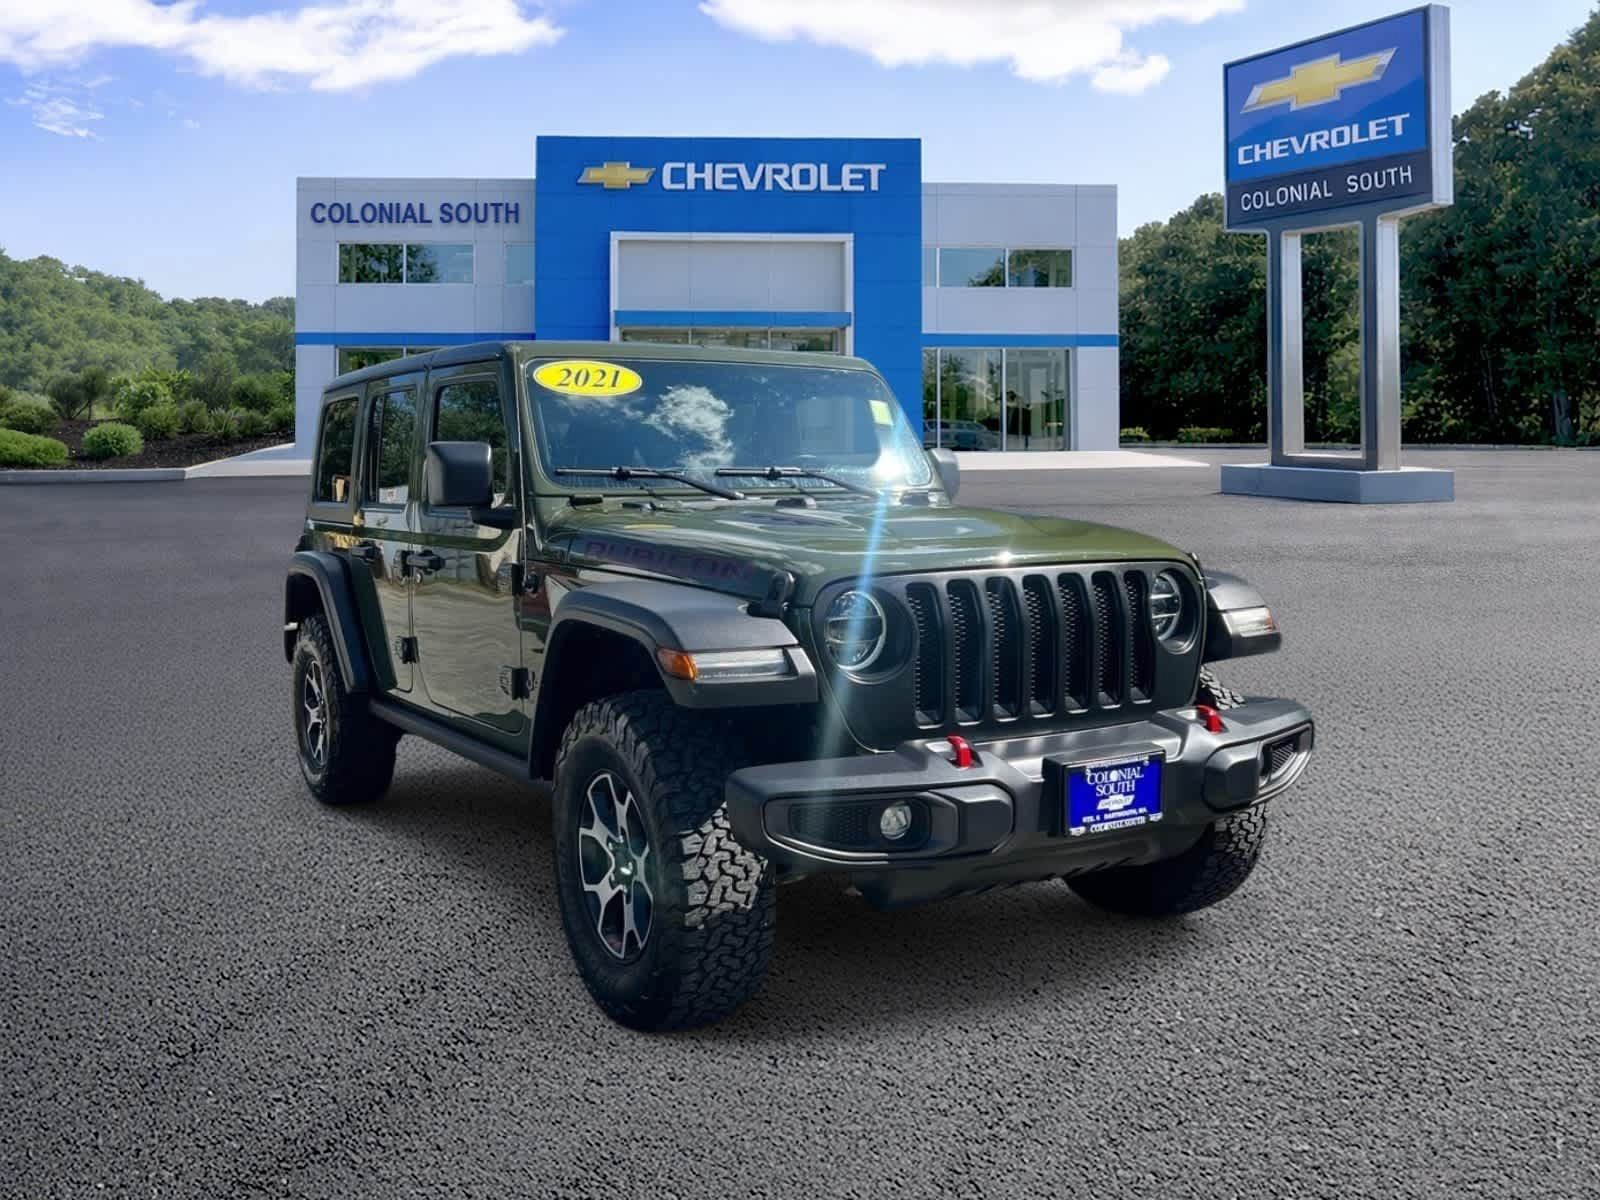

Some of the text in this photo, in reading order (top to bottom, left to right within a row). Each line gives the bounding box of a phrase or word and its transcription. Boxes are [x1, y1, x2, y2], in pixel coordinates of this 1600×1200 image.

[1237, 113, 1410, 165] CHEVROLET
[662, 162, 887, 191] CHEVROLET
[1240, 165, 1412, 211] COLONIAL SOUTH
[310, 202, 520, 224] COLONIAL SOUTH
[556, 368, 621, 388] 2021
[585, 541, 755, 580] RUBICON
[1087, 767, 1145, 785] COLONIAL
[1095, 780, 1135, 797] SOUTH
